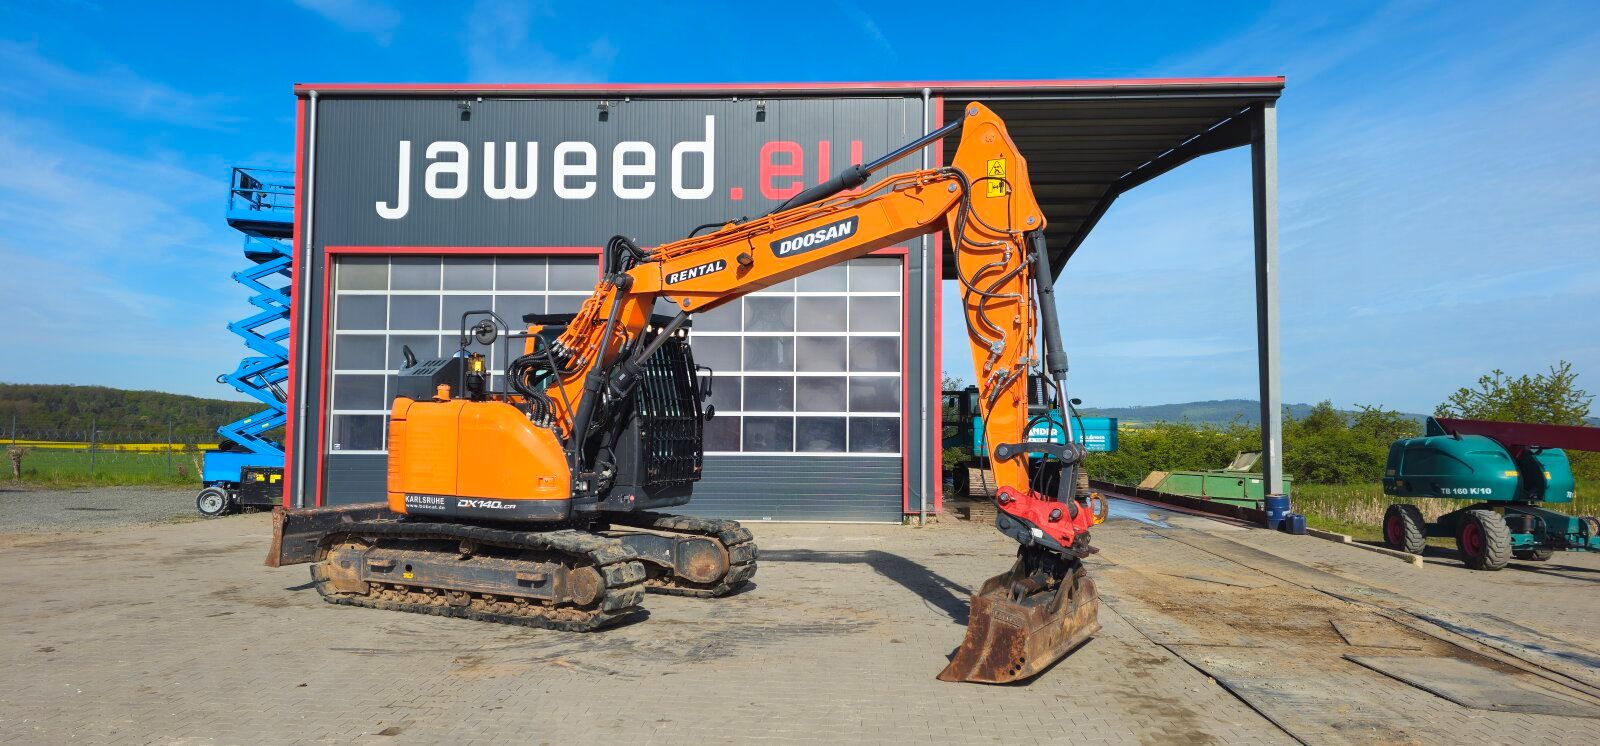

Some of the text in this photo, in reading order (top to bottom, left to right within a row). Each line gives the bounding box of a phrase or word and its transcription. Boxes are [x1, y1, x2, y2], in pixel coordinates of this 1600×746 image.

[375, 115, 863, 220] jaweed.eu
[779, 221, 852, 255] DOOSAN
[669, 261, 723, 284] RENTAL
[405, 495, 445, 505] KARLSRUHE
[1440, 487, 1492, 495] TB 160 K/10
